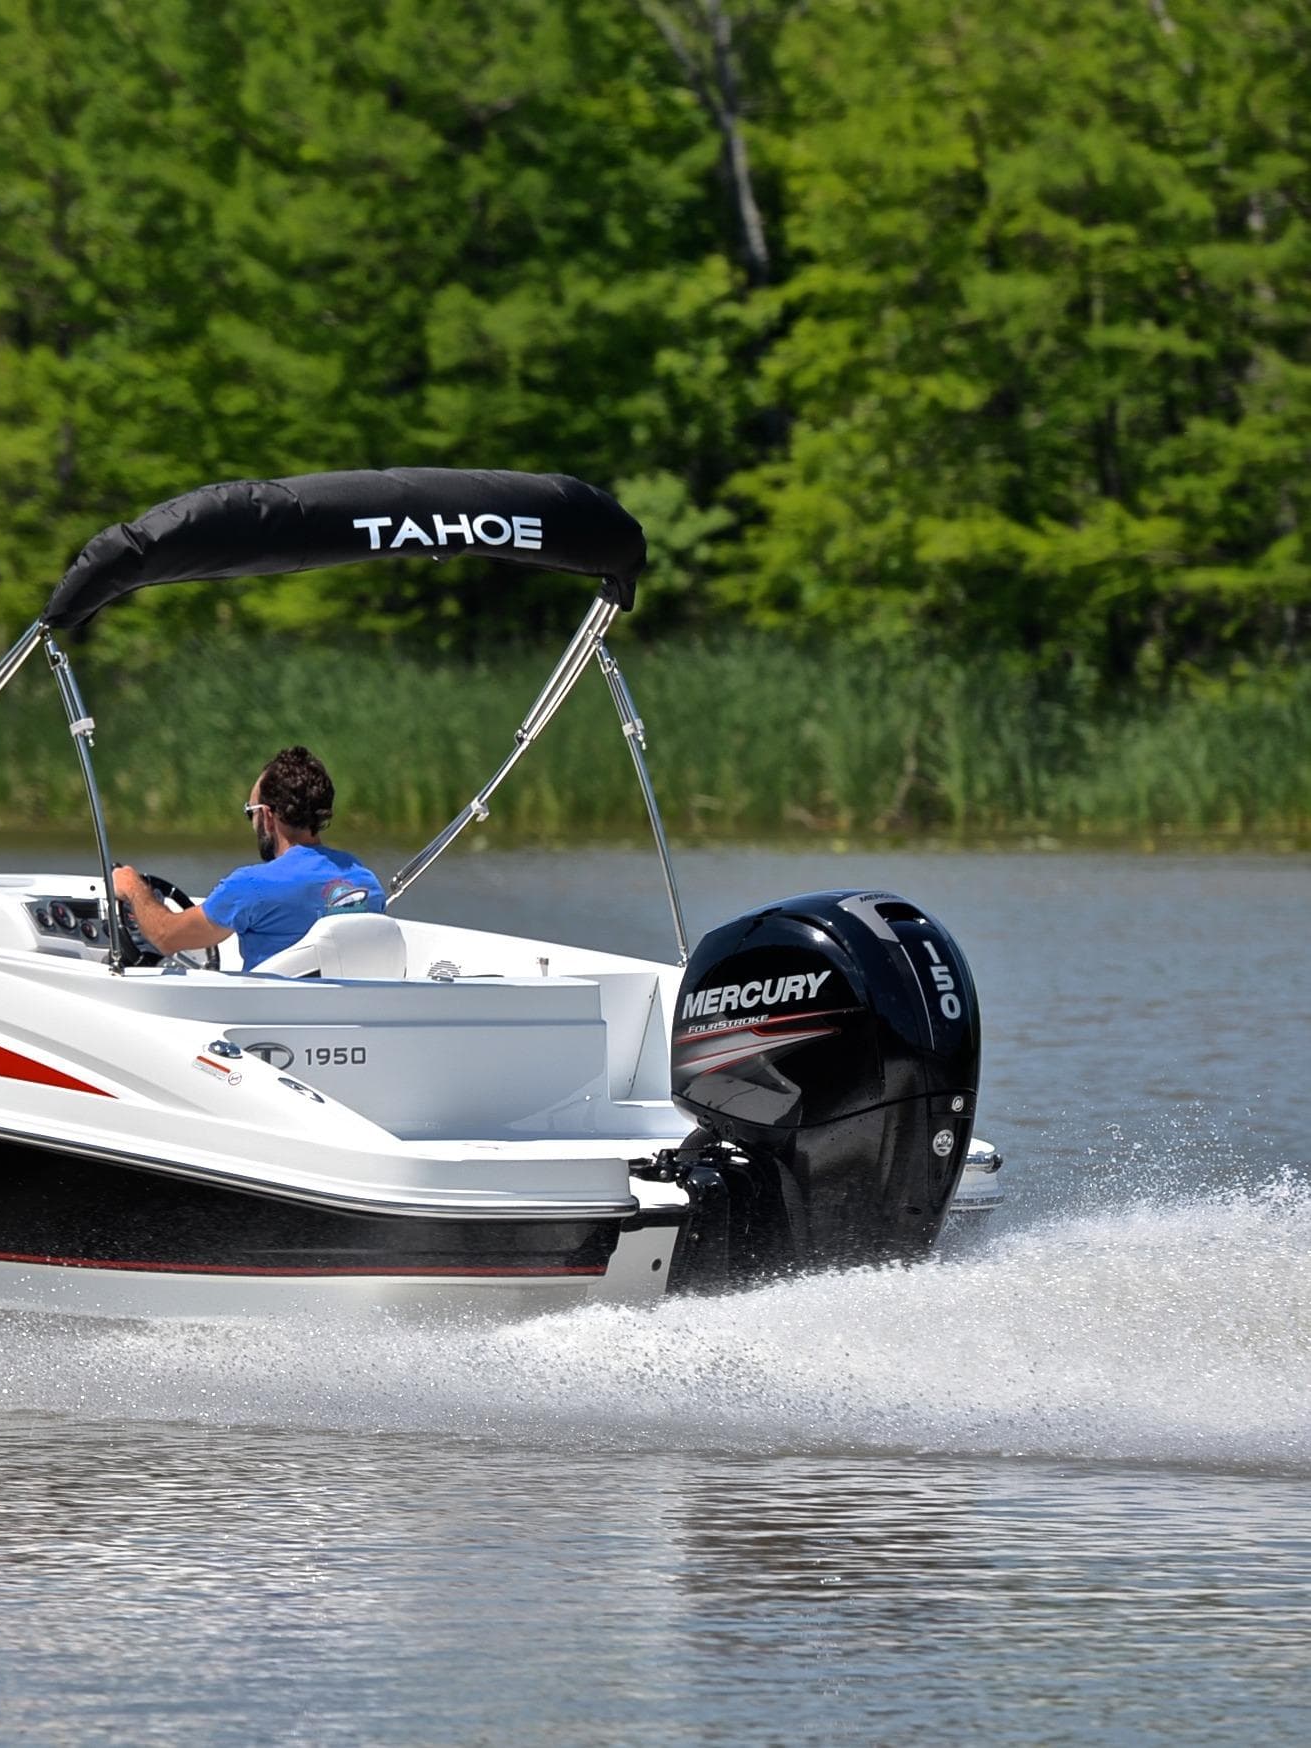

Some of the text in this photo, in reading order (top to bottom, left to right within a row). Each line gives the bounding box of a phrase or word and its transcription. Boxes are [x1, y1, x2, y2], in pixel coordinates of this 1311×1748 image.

[353, 514, 542, 549] TAHOE
[682, 970, 832, 1020] MERCURY
[922, 941, 961, 1019] 150
[305, 1047, 366, 1066] 1950
